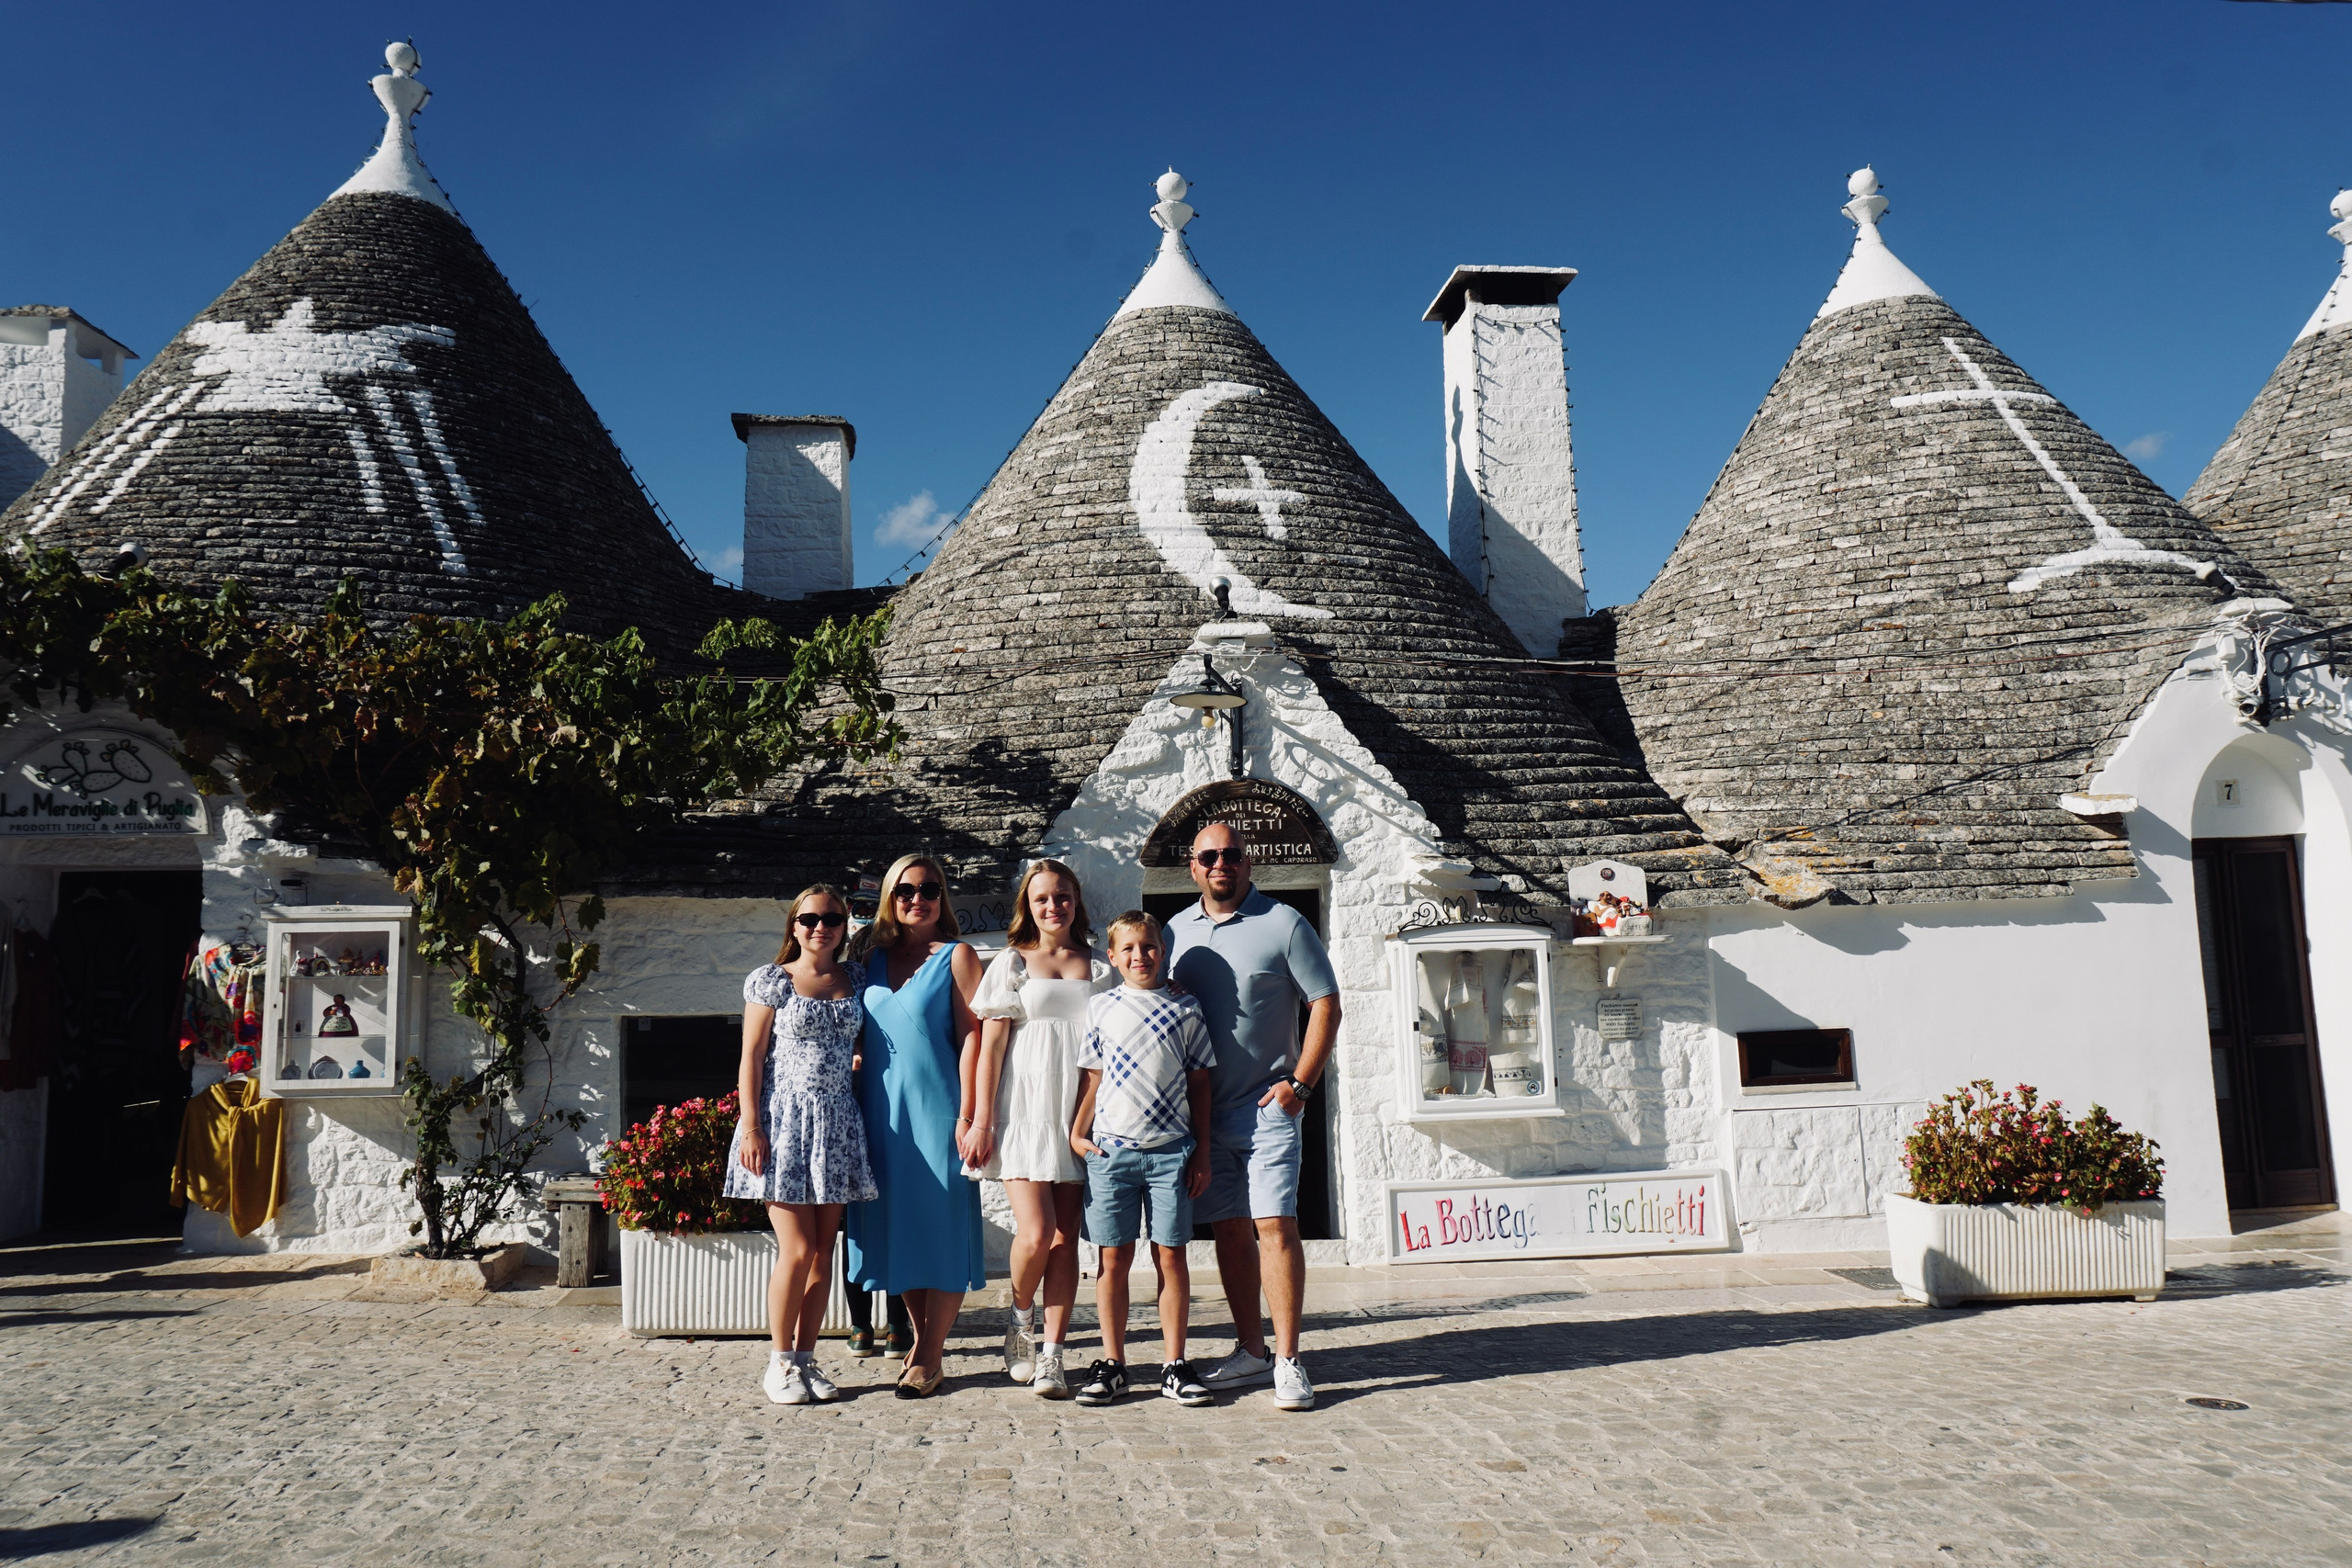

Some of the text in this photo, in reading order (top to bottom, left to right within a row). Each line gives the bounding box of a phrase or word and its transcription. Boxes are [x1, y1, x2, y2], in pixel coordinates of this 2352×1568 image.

[2224, 784, 2233, 800] 7
[0, 791, 193, 822] Le Meraviglie di Puglia
[1220, 798, 1283, 818] BOTTEGA
[10, 821, 182, 831] PRODOTTI TIPICI & ARTIGIANATO
[1245, 842, 1312, 856] ARTISTICA
[1399, 1210, 1432, 1252] La
[1585, 1181, 1705, 1236] Fischietti
